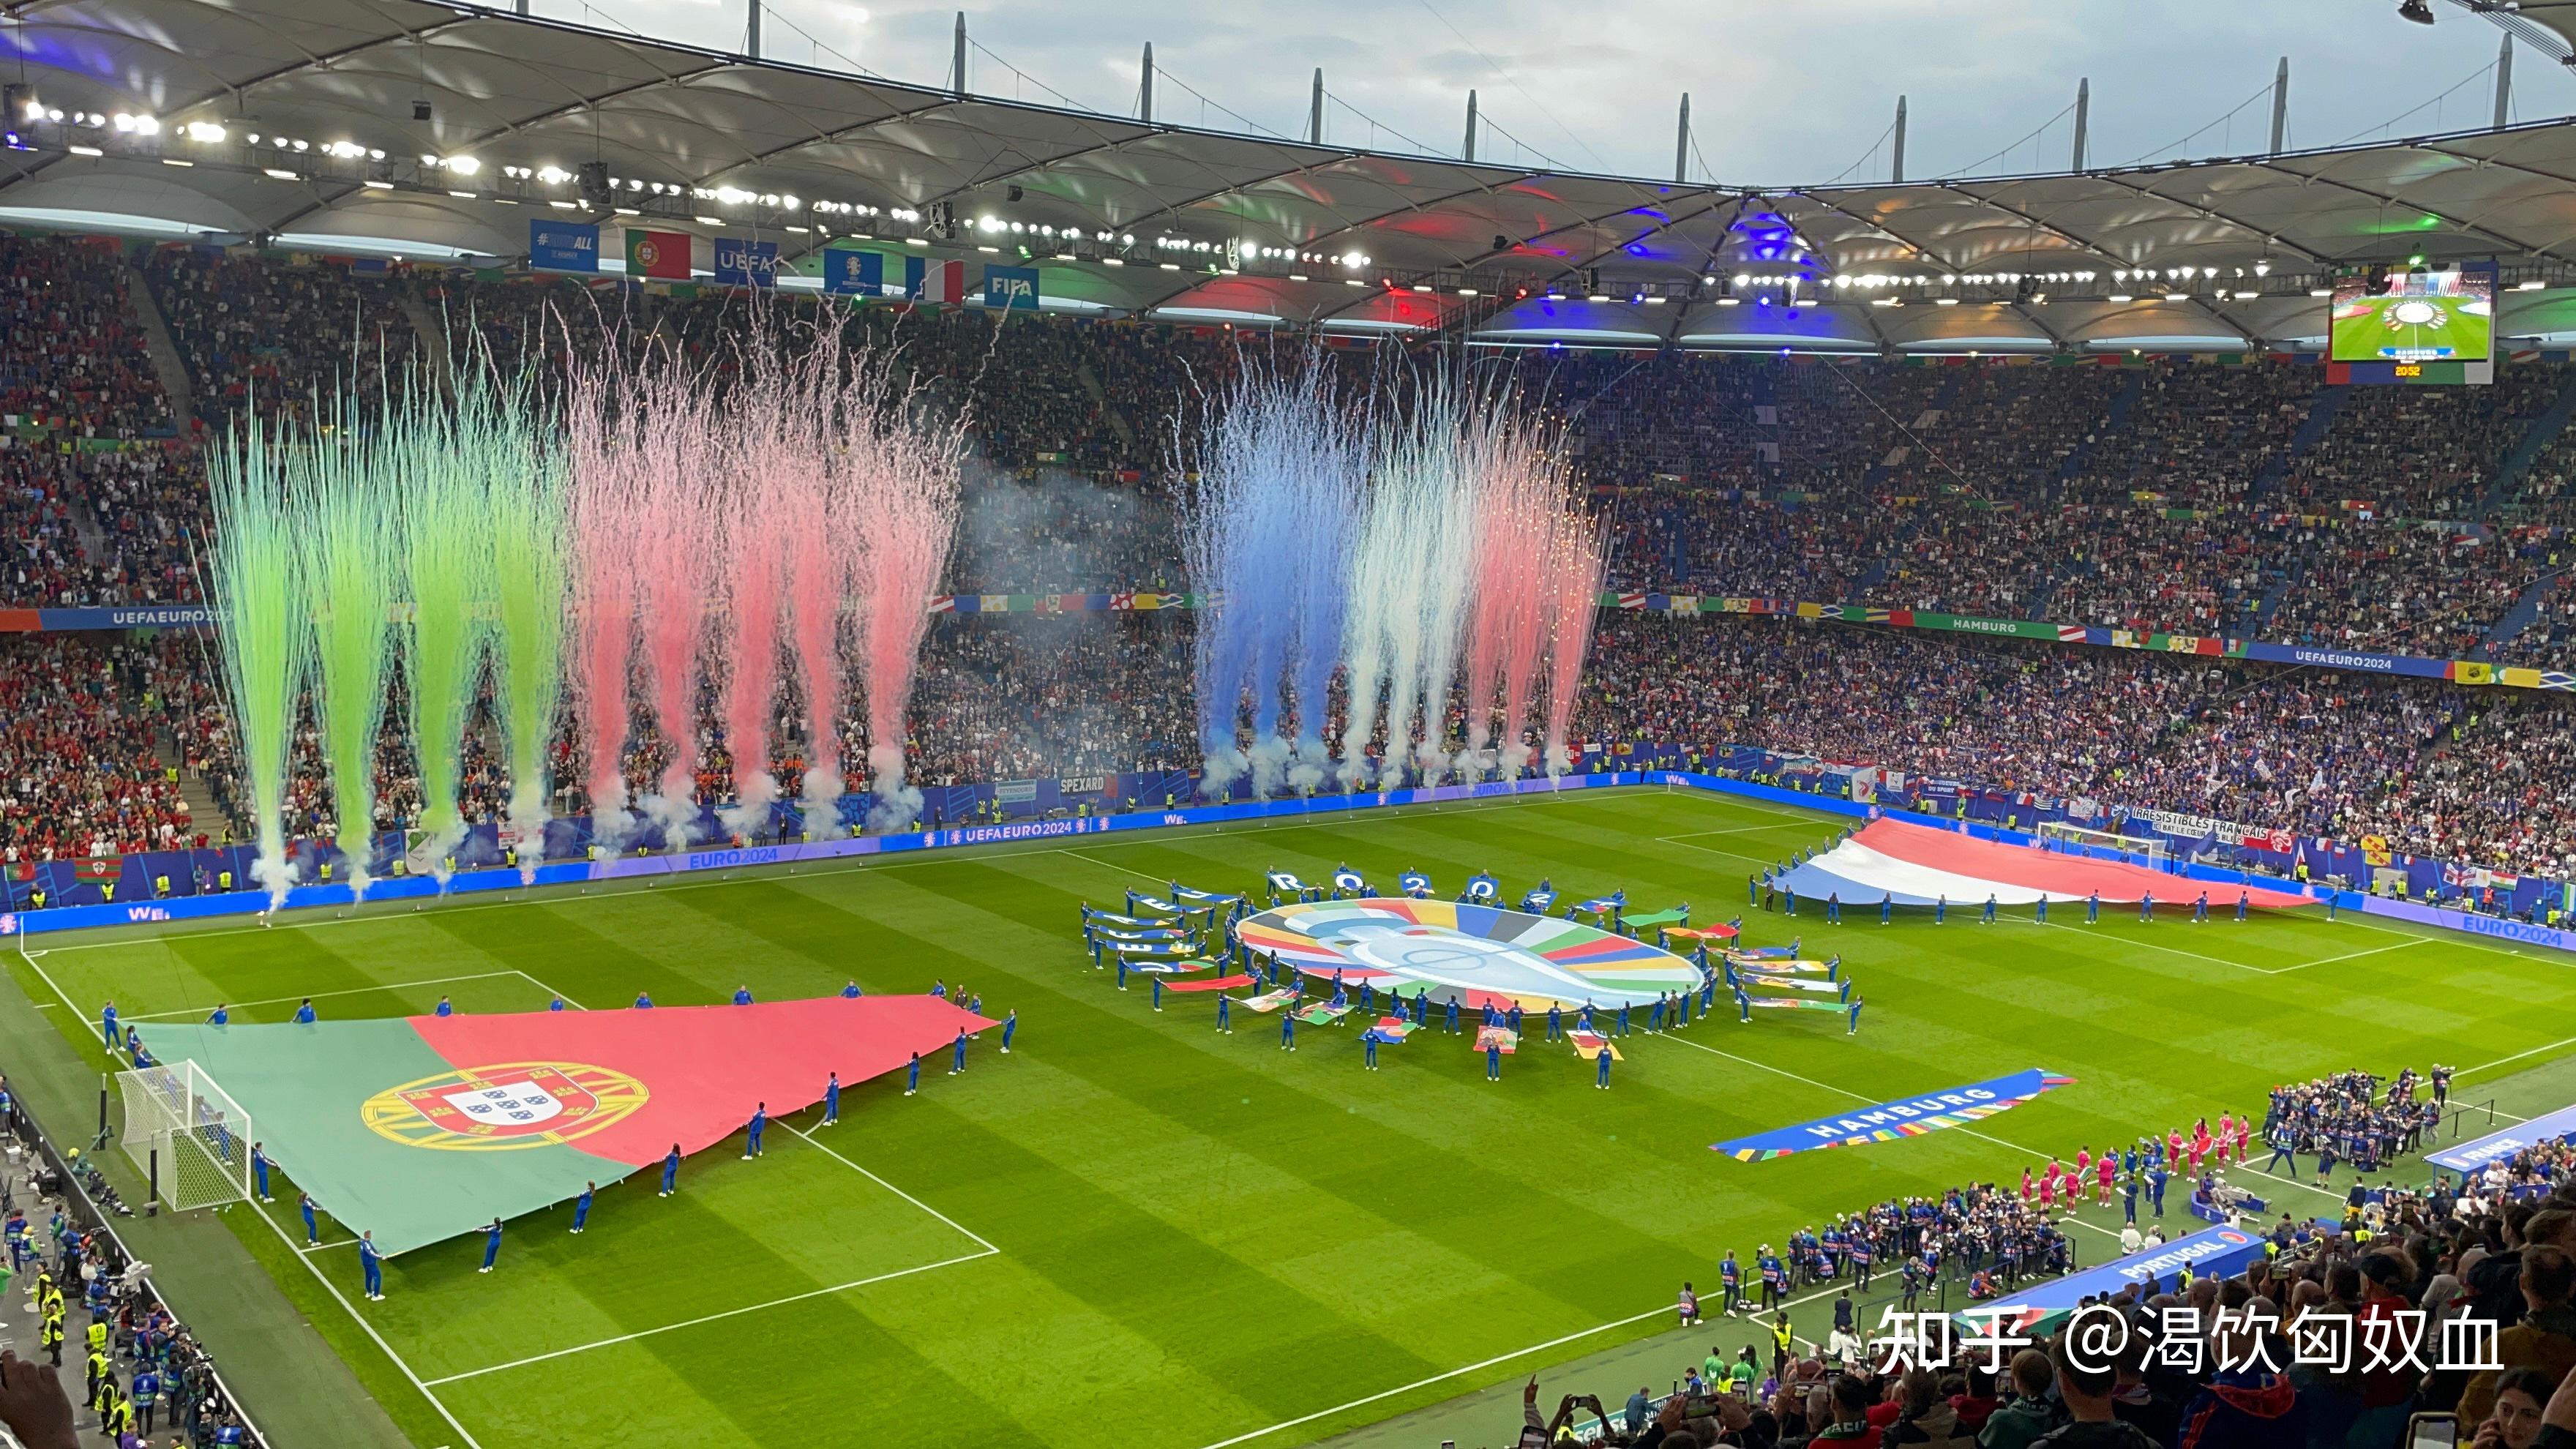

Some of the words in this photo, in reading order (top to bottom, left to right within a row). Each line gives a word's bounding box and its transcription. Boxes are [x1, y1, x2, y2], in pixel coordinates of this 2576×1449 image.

[720, 252, 771, 272] UEFA
[992, 277, 1033, 296] FIFA
[113, 610, 236, 624] UEFAEURO202
[1953, 619, 2017, 633] HAMBURG
[1061, 776, 1104, 793] SPEXARD
[2133, 808, 2209, 829] IRRESISTIBLES
[690, 848, 777, 869] EURO2024
[2463, 916, 2563, 946] EURO2024
[1805, 1089, 1996, 1138] HAMBURG
[2119, 1240, 2227, 1278] PORTUGAL
